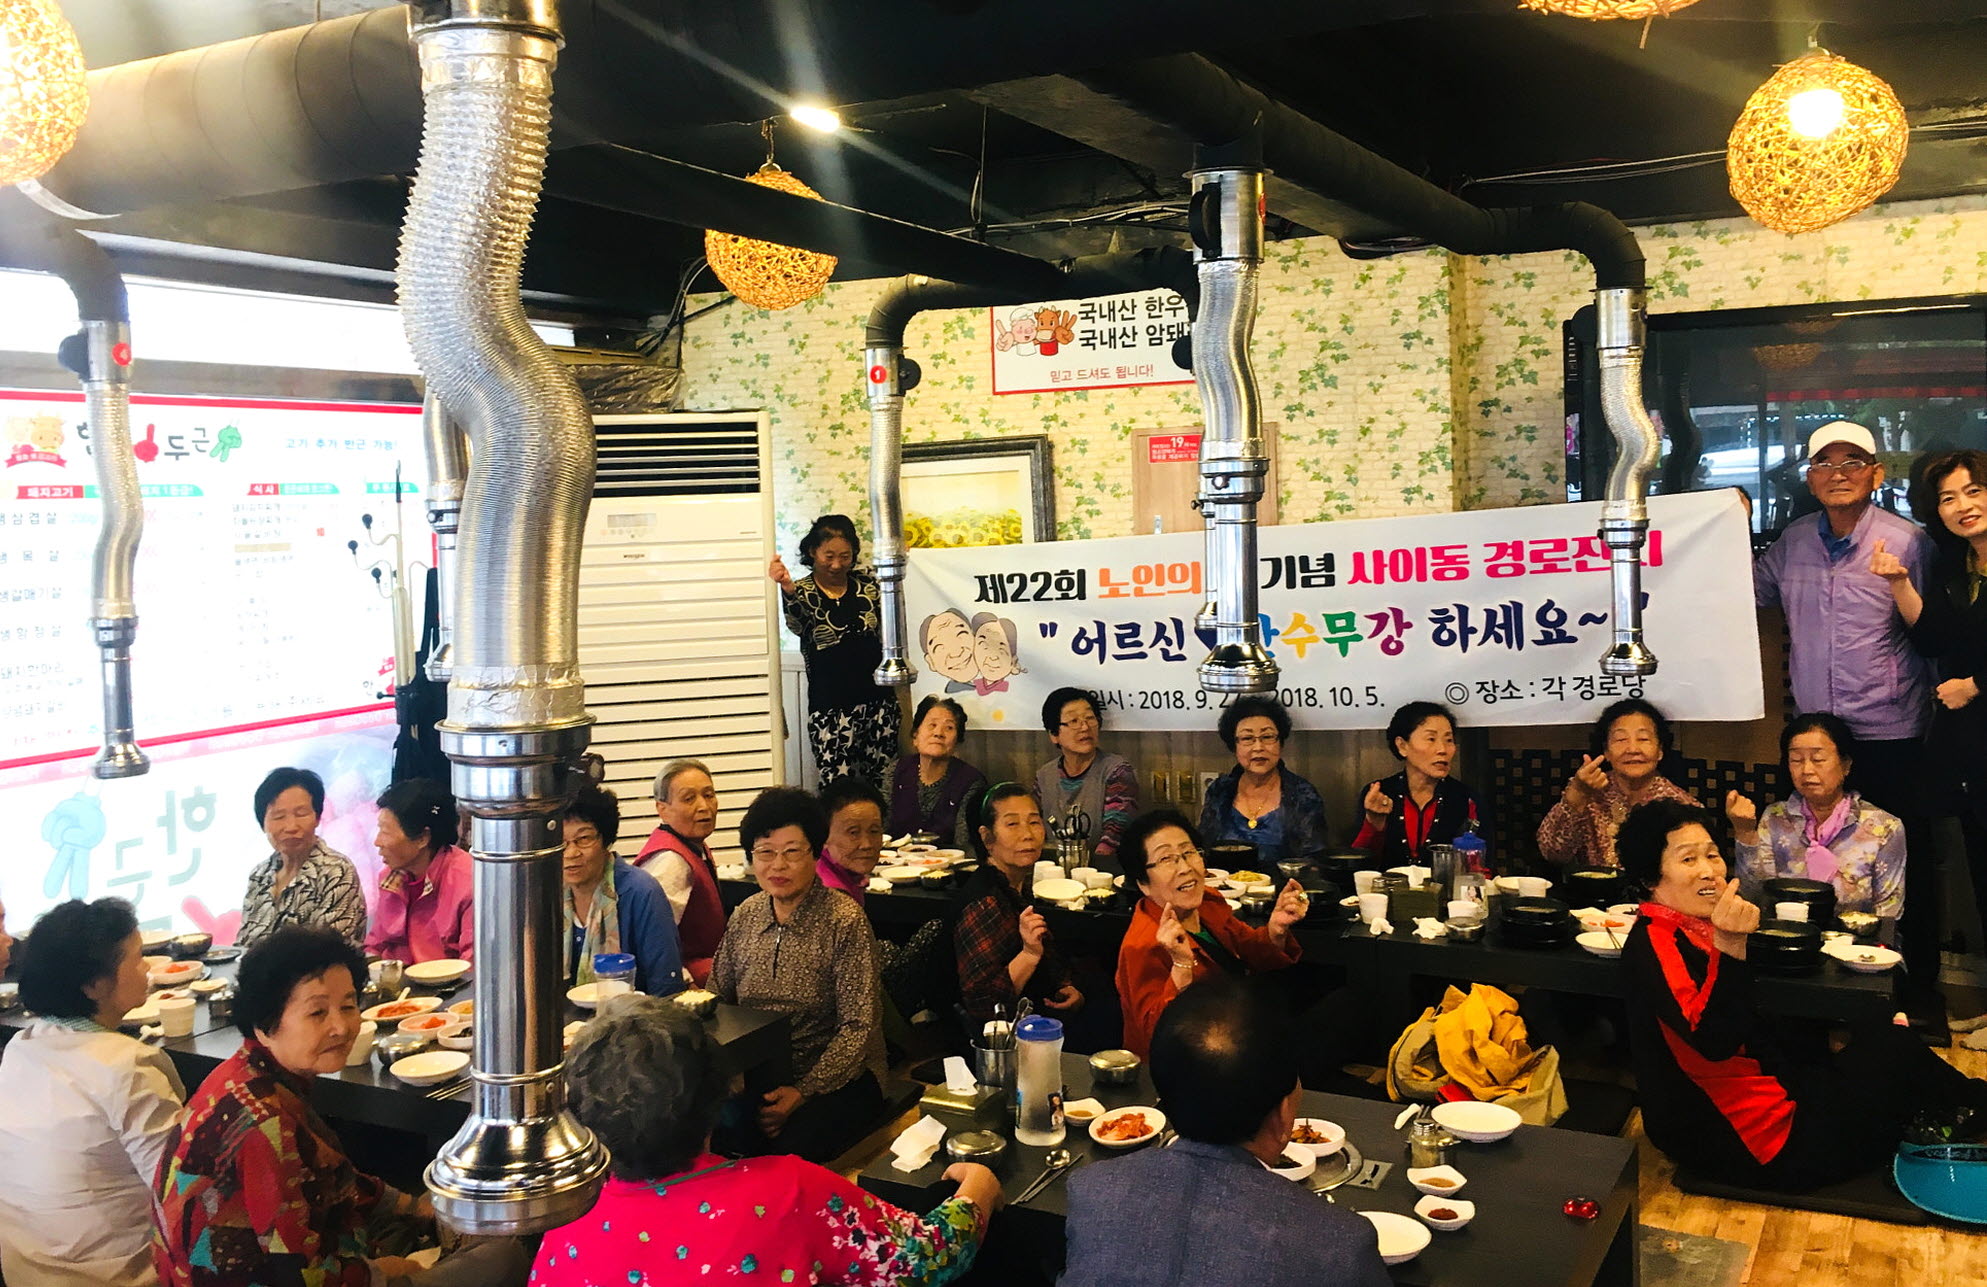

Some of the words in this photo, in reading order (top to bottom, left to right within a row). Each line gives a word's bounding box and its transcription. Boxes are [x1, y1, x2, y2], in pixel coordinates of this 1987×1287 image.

[1078, 298, 1137, 324] 국내산
[1144, 294, 1185, 320] 한우
[1078, 325, 1138, 350] 국내산
[1146, 321, 1190, 347] 암돼
[1050, 369, 1072, 383] 믿고
[1077, 366, 1111, 380] 드셔도
[1115, 364, 1154, 379] 됩니다!
[286, 438, 308, 449] 고기
[316, 438, 338, 449] 추가
[1170, 436, 1185, 448] 19
[27, 486, 74, 497] 돼지고기
[973, 568, 1087, 605] 제22회
[1098, 561, 1202, 598] 노인의
[1260, 552, 1336, 590] 기념
[1347, 543, 1470, 585] 사이동
[1541, 676, 1567, 701] 각
[1572, 674, 1646, 701] 경로당
